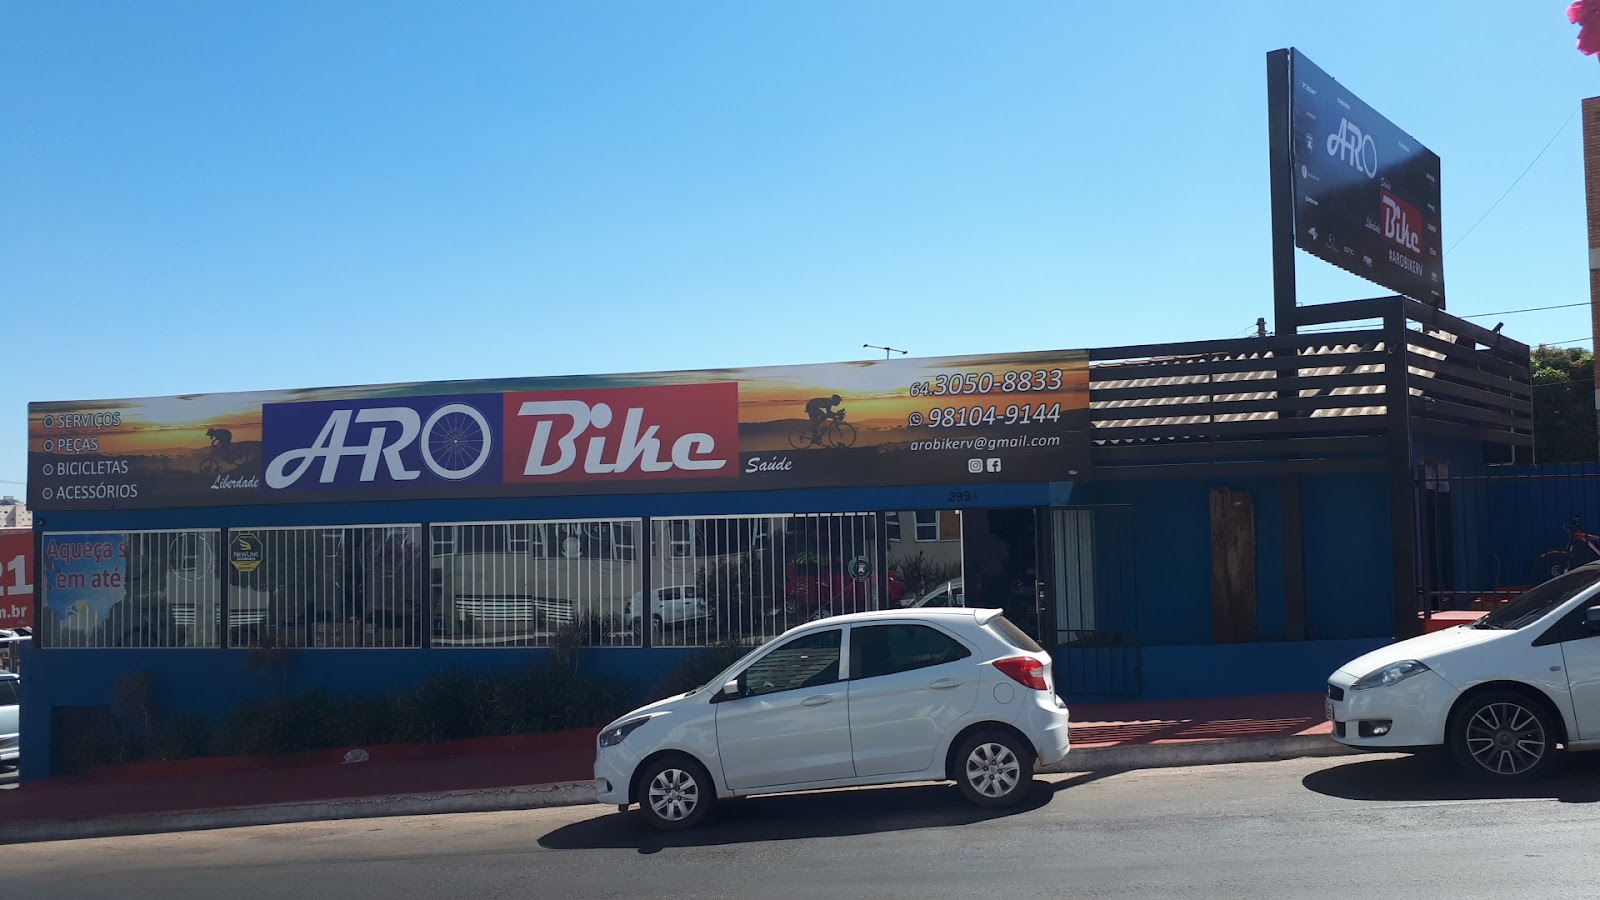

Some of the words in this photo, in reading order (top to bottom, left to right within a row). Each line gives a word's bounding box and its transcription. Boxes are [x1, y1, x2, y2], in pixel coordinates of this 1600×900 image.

[1327, 117, 1378, 179] ARO
[1382, 194, 1421, 254] Bike
[1388, 248, 1423, 277] #AROBIKERV
[57, 412, 121, 430] SERVIÇOS
[927, 403, 1061, 427] 98104-9144
[57, 437, 98, 454] PEÇAS
[264, 403, 492, 489] ARO
[517, 399, 727, 476] Bike
[910, 435, 1060, 451] arobikerv@gmail.com
[57, 460, 129, 476] BICICLETAS
[745, 456, 793, 474] Saúde
[56, 482, 138, 500] ACESSÓRIOS
[210, 474, 260, 490] Liberdade
[47, 538, 113, 566] Aqueça
[56, 570, 85, 589] em
[91, 565, 121, 589] até
